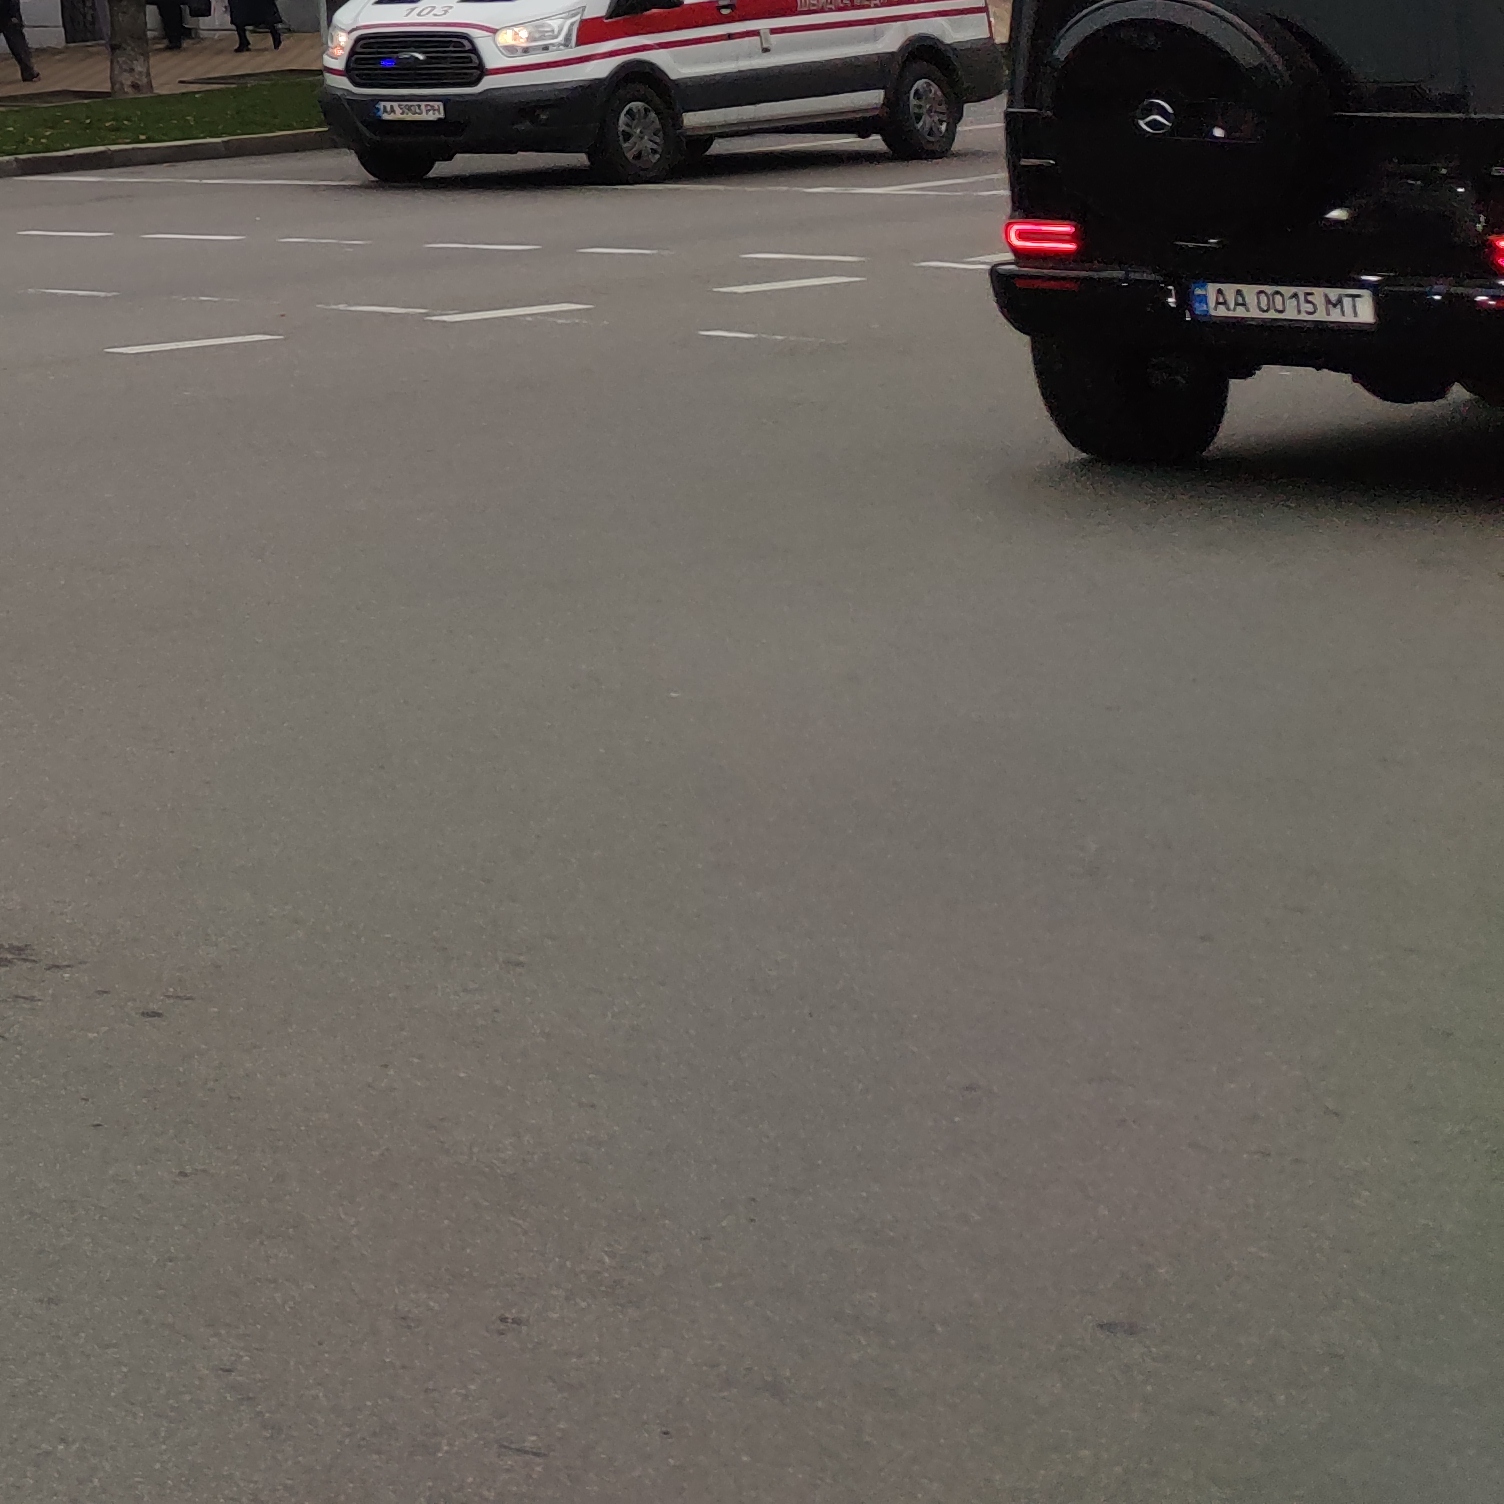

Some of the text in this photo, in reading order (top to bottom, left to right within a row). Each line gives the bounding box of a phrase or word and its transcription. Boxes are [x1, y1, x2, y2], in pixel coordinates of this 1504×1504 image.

[403, 5, 454, 18] 103
[1213, 288, 1364, 317] AA 0015 MT
